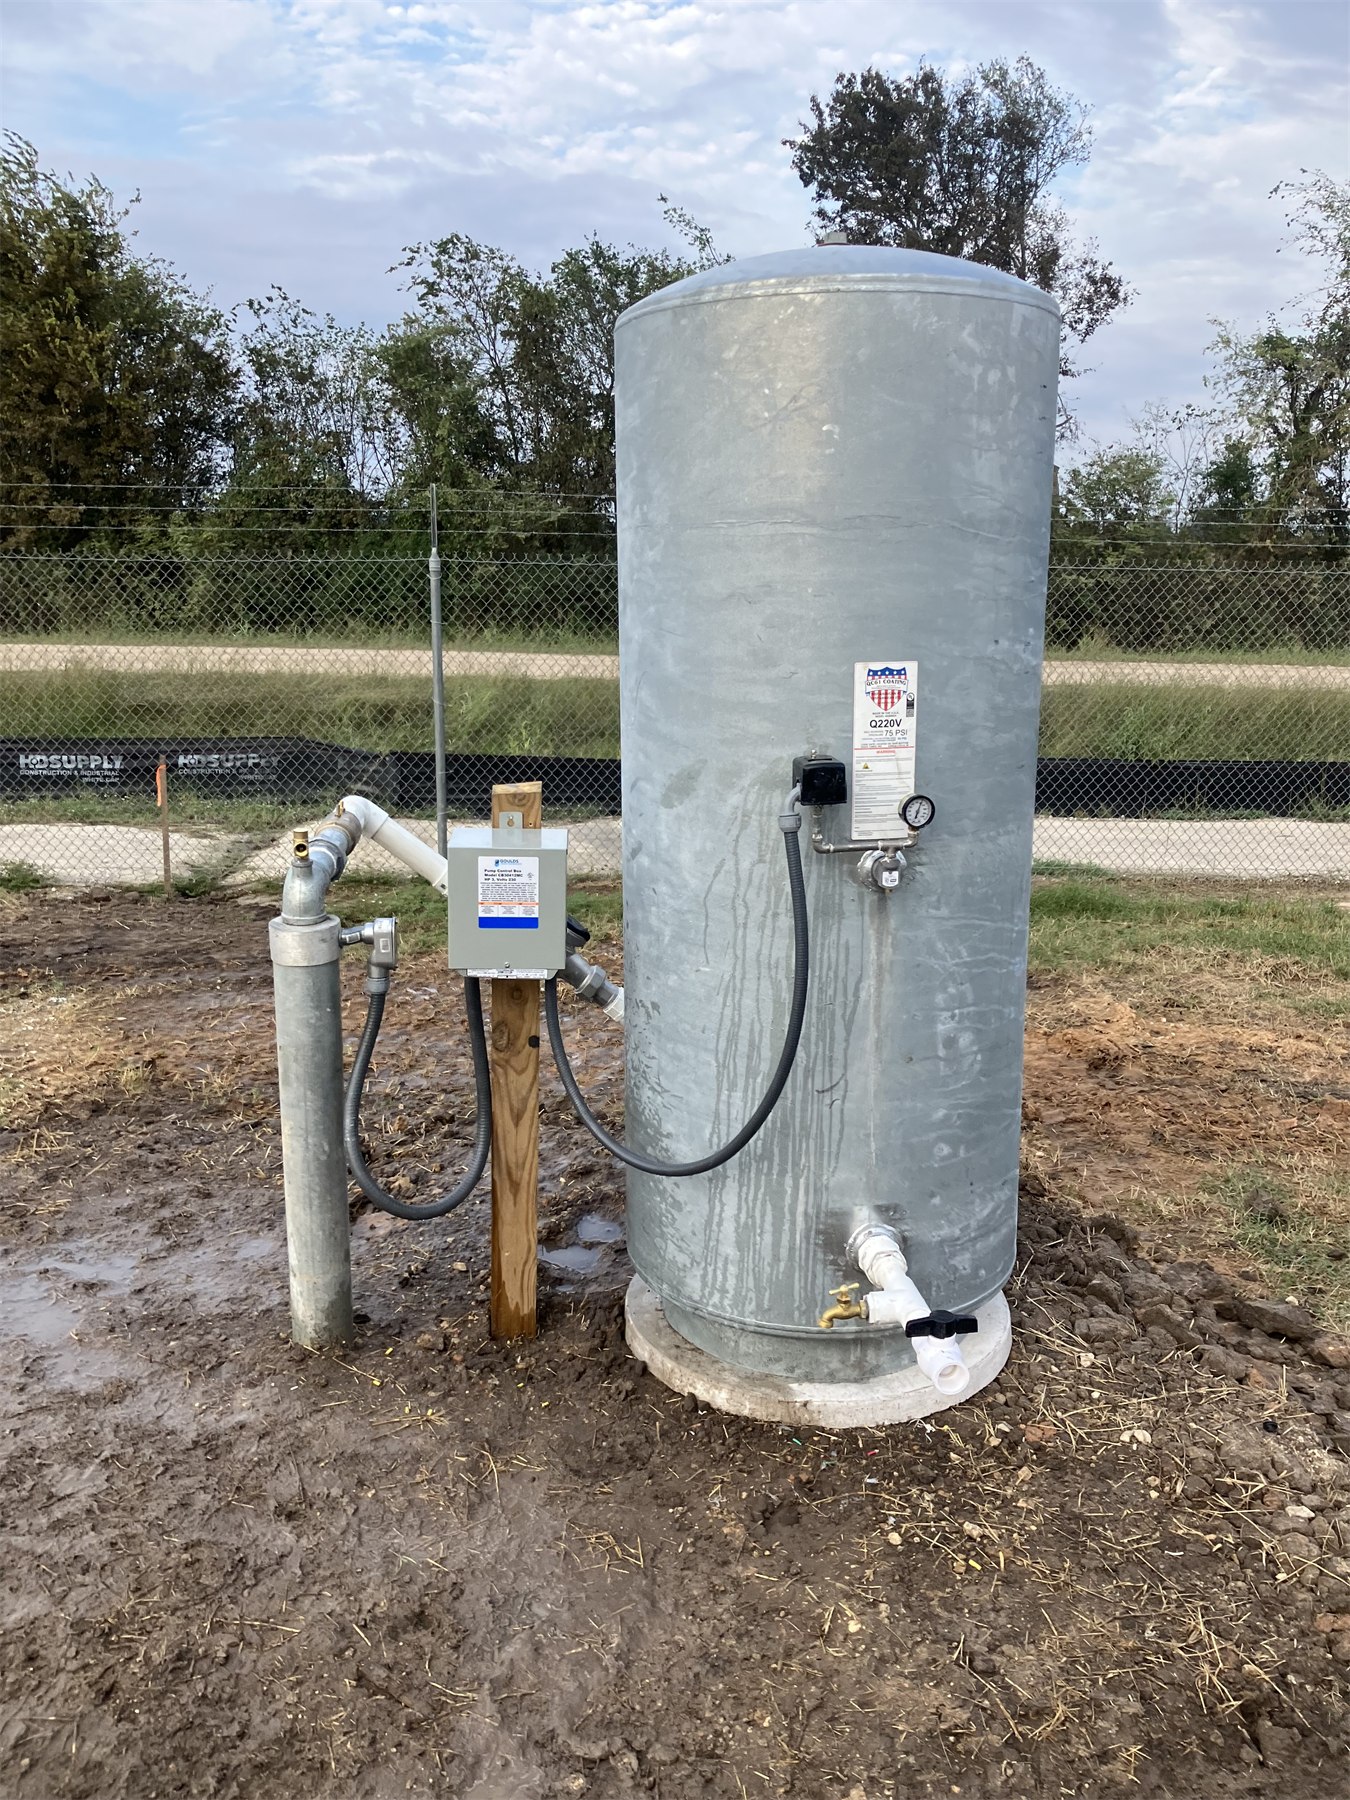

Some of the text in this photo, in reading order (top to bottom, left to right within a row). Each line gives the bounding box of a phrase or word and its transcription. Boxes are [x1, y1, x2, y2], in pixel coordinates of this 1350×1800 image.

[869, 719, 902, 729] Q220V
[884, 729, 894, 737] 75
[895, 729, 908, 737] PSI
